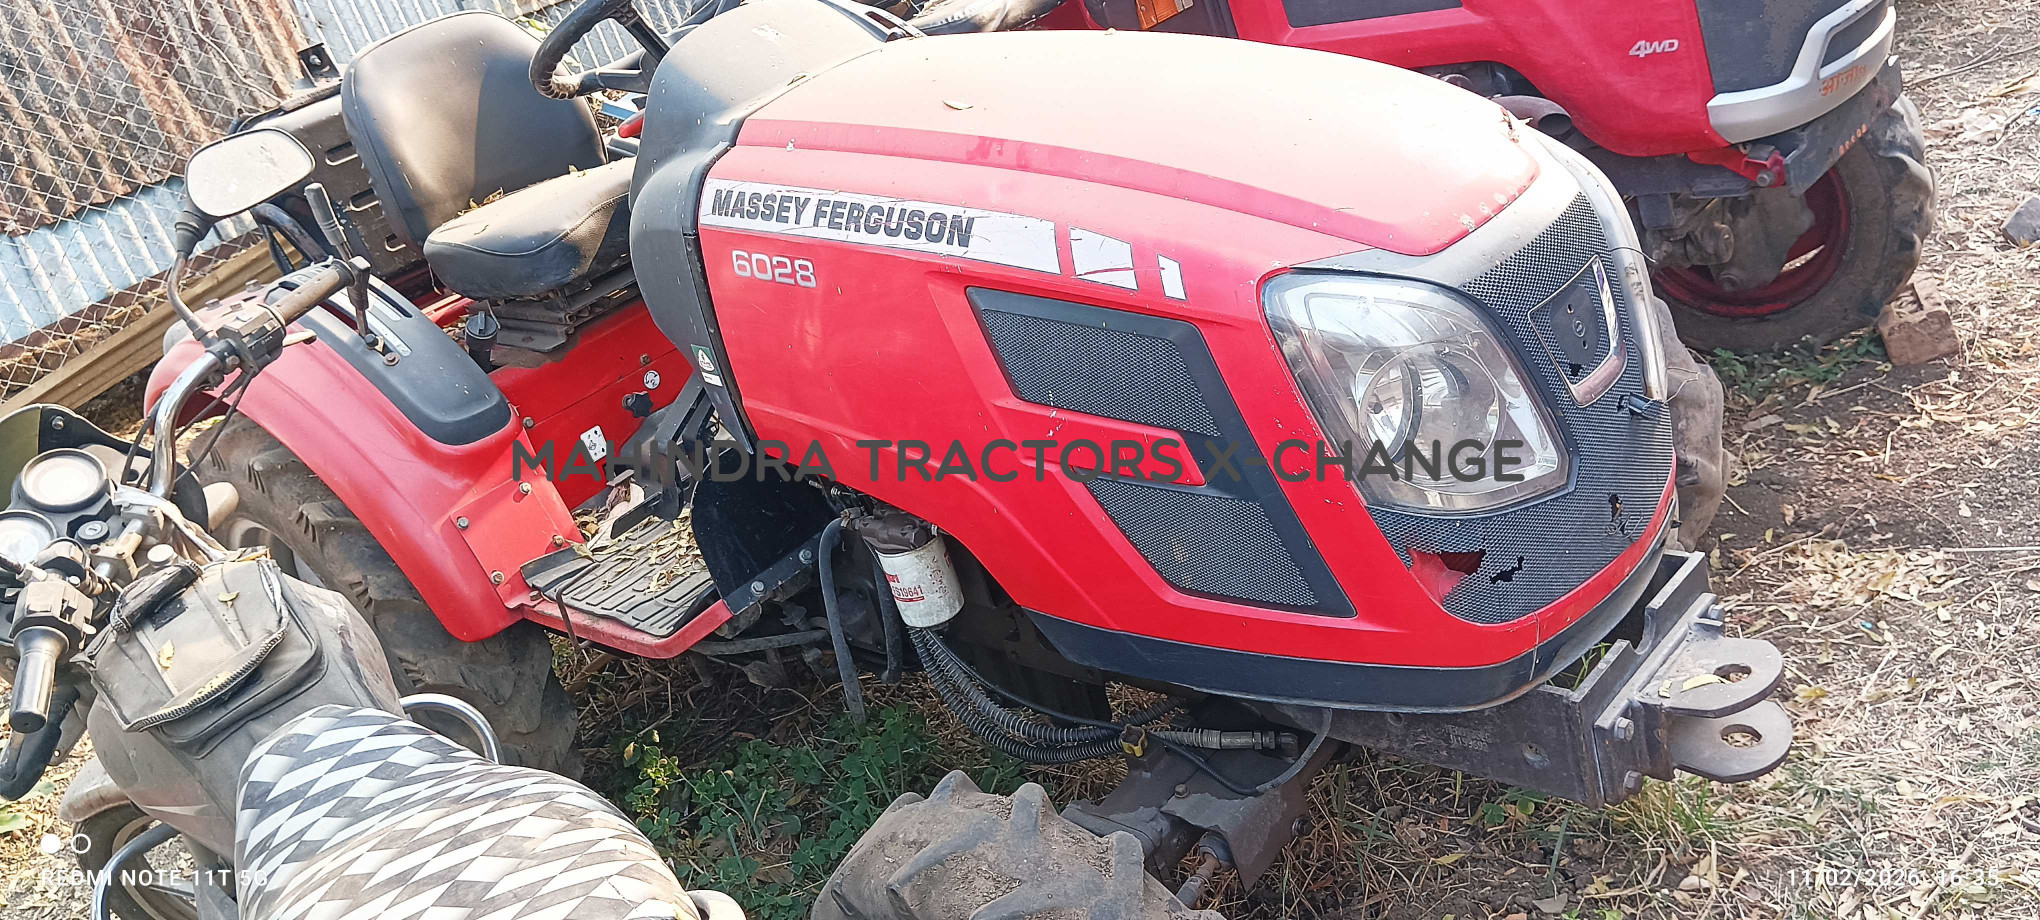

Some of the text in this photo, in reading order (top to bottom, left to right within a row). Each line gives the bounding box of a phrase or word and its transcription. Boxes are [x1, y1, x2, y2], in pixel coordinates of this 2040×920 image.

[1629, 39, 1679, 57] 4WD
[711, 189, 975, 248] MASSEY FERGUSON
[731, 250, 817, 288] 6028
